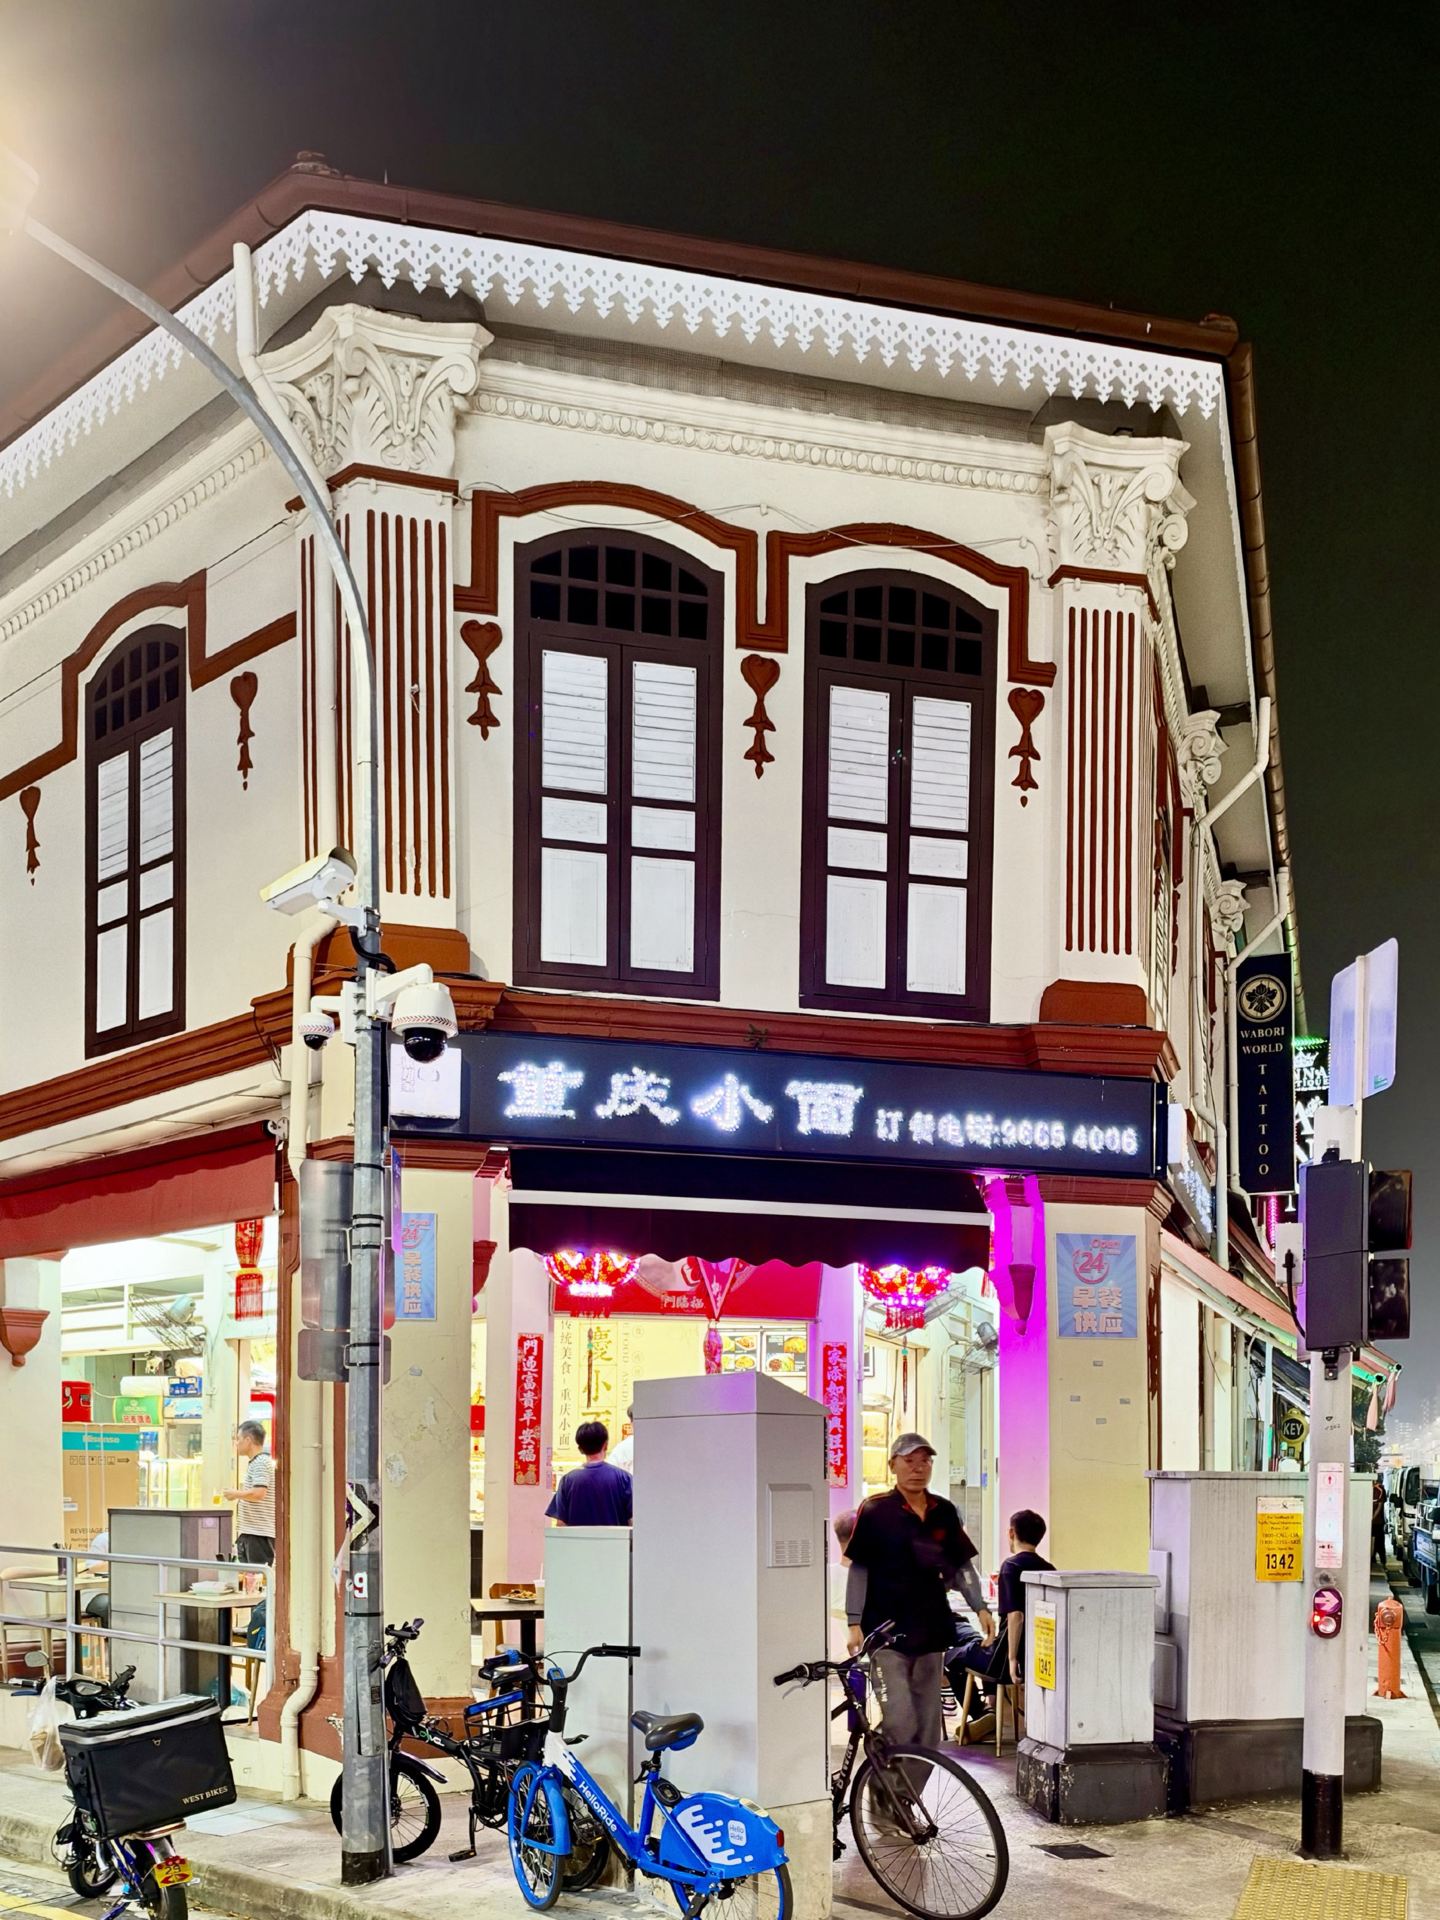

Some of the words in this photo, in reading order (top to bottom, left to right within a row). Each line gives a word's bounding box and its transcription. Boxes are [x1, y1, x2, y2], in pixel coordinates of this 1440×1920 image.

[1240, 1026, 1285, 1039] WABORI
[1242, 1042, 1284, 1055] WORLD
[497, 1060, 864, 1138] 重庆小面
[1258, 1063, 1270, 1175] TATTOO
[1079, 1251, 1105, 1273] 24
[1283, 1422, 1303, 1436] KEY
[1265, 1553, 1295, 1570] 1342
[1038, 1657, 1052, 1677] 1342
[182, 1793, 205, 1805] WEST
[205, 1785, 229, 1799] BIKES
[578, 1781, 618, 1832] HelloRide
